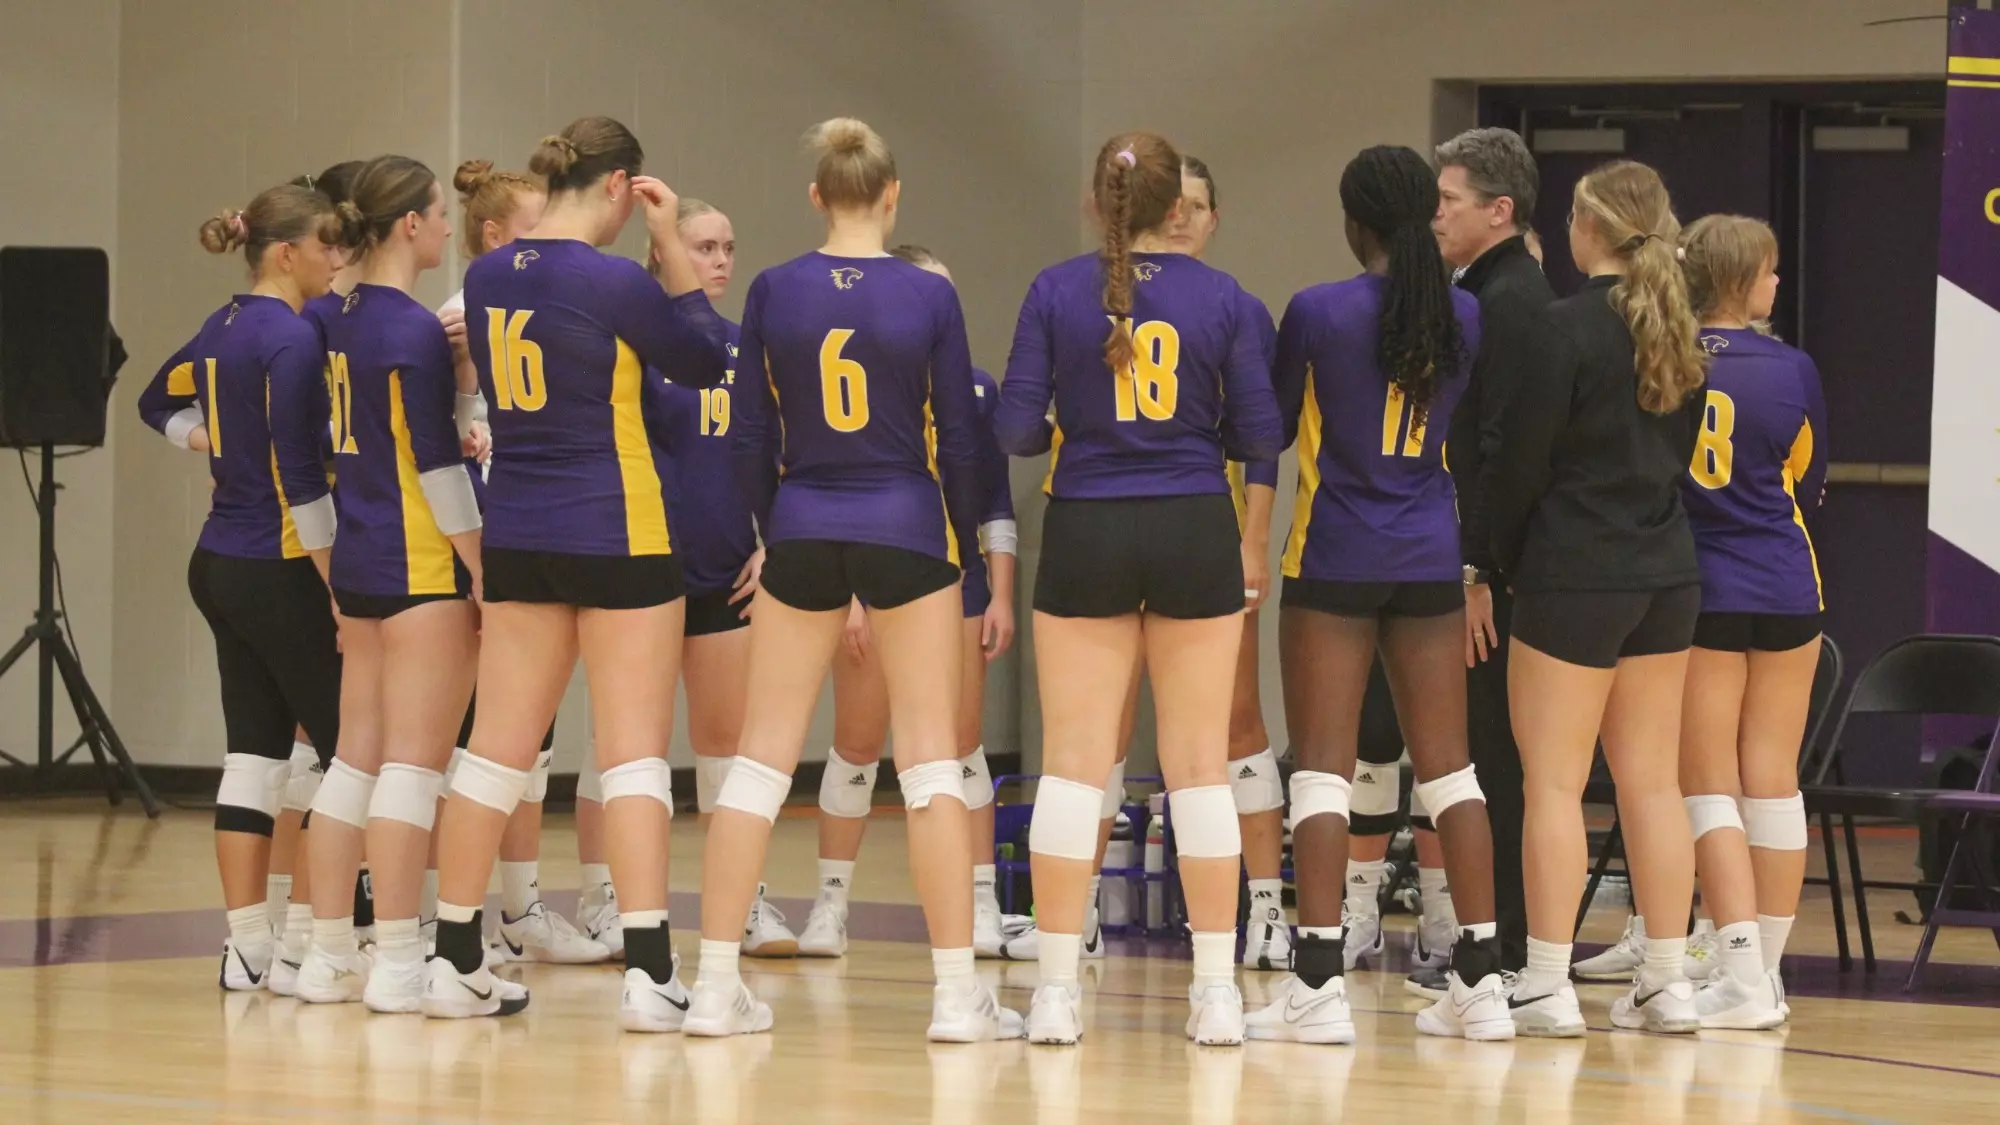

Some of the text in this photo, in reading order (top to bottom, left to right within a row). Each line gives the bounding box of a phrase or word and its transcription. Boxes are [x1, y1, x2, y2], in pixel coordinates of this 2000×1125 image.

[205, 358, 222, 457] 1
[485, 306, 548, 411] 16
[819, 328, 869, 432] 6
[1106, 315, 1180, 421] 18
[699, 388, 731, 436] 19
[1689, 389, 1735, 489] 8
